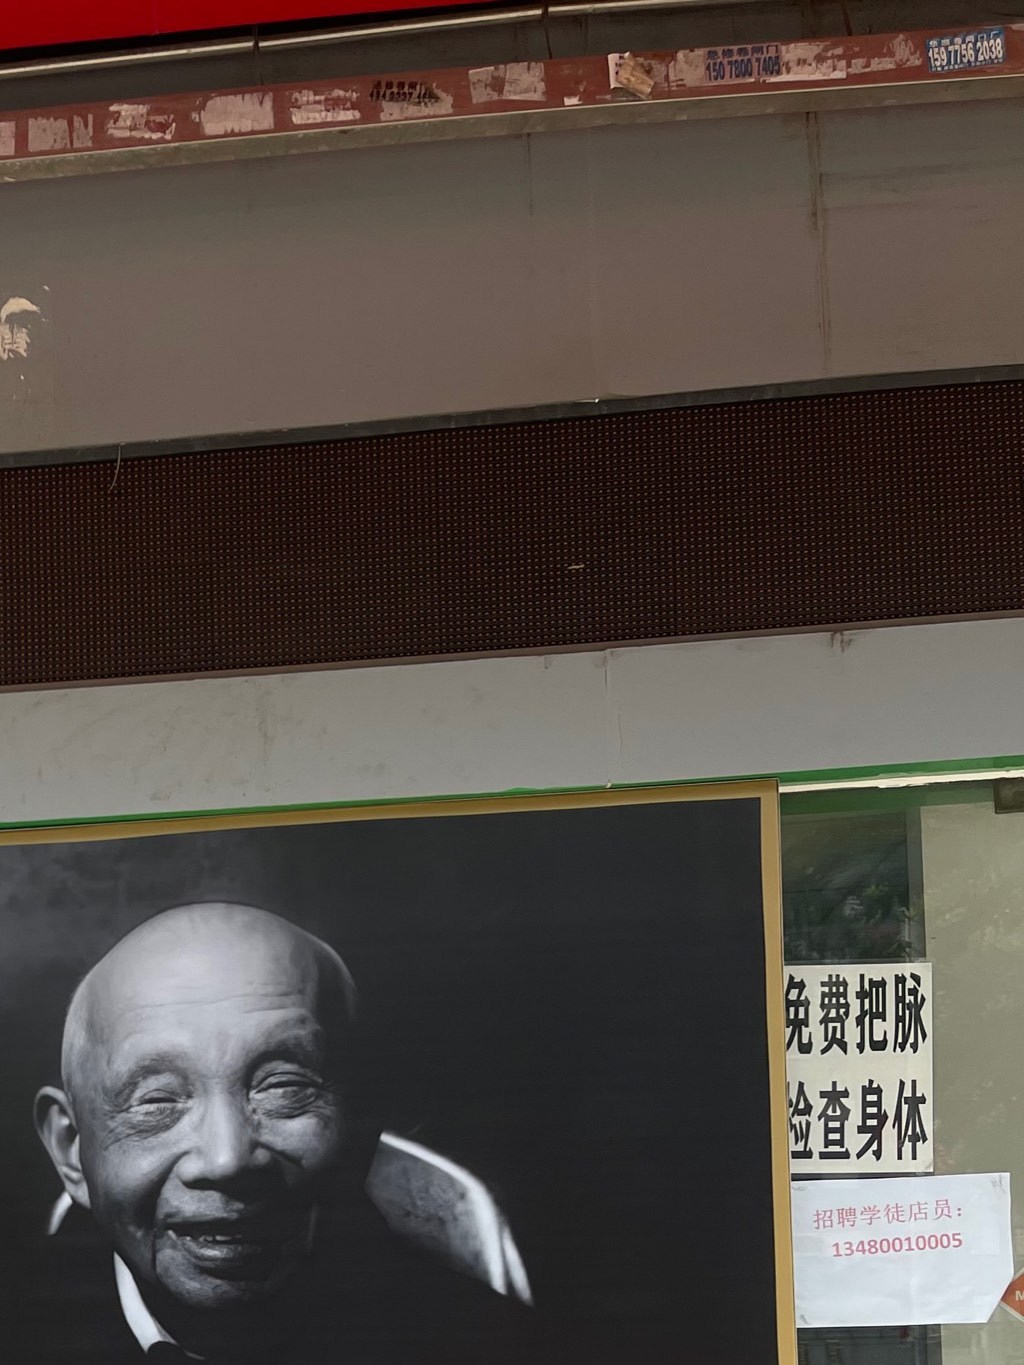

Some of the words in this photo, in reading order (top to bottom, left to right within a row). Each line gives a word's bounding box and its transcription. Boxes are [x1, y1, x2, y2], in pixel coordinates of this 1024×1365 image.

[928, 46, 947, 67] 159
[976, 38, 1003, 61] 2038
[831, 1232, 964, 1258] 13480010005
